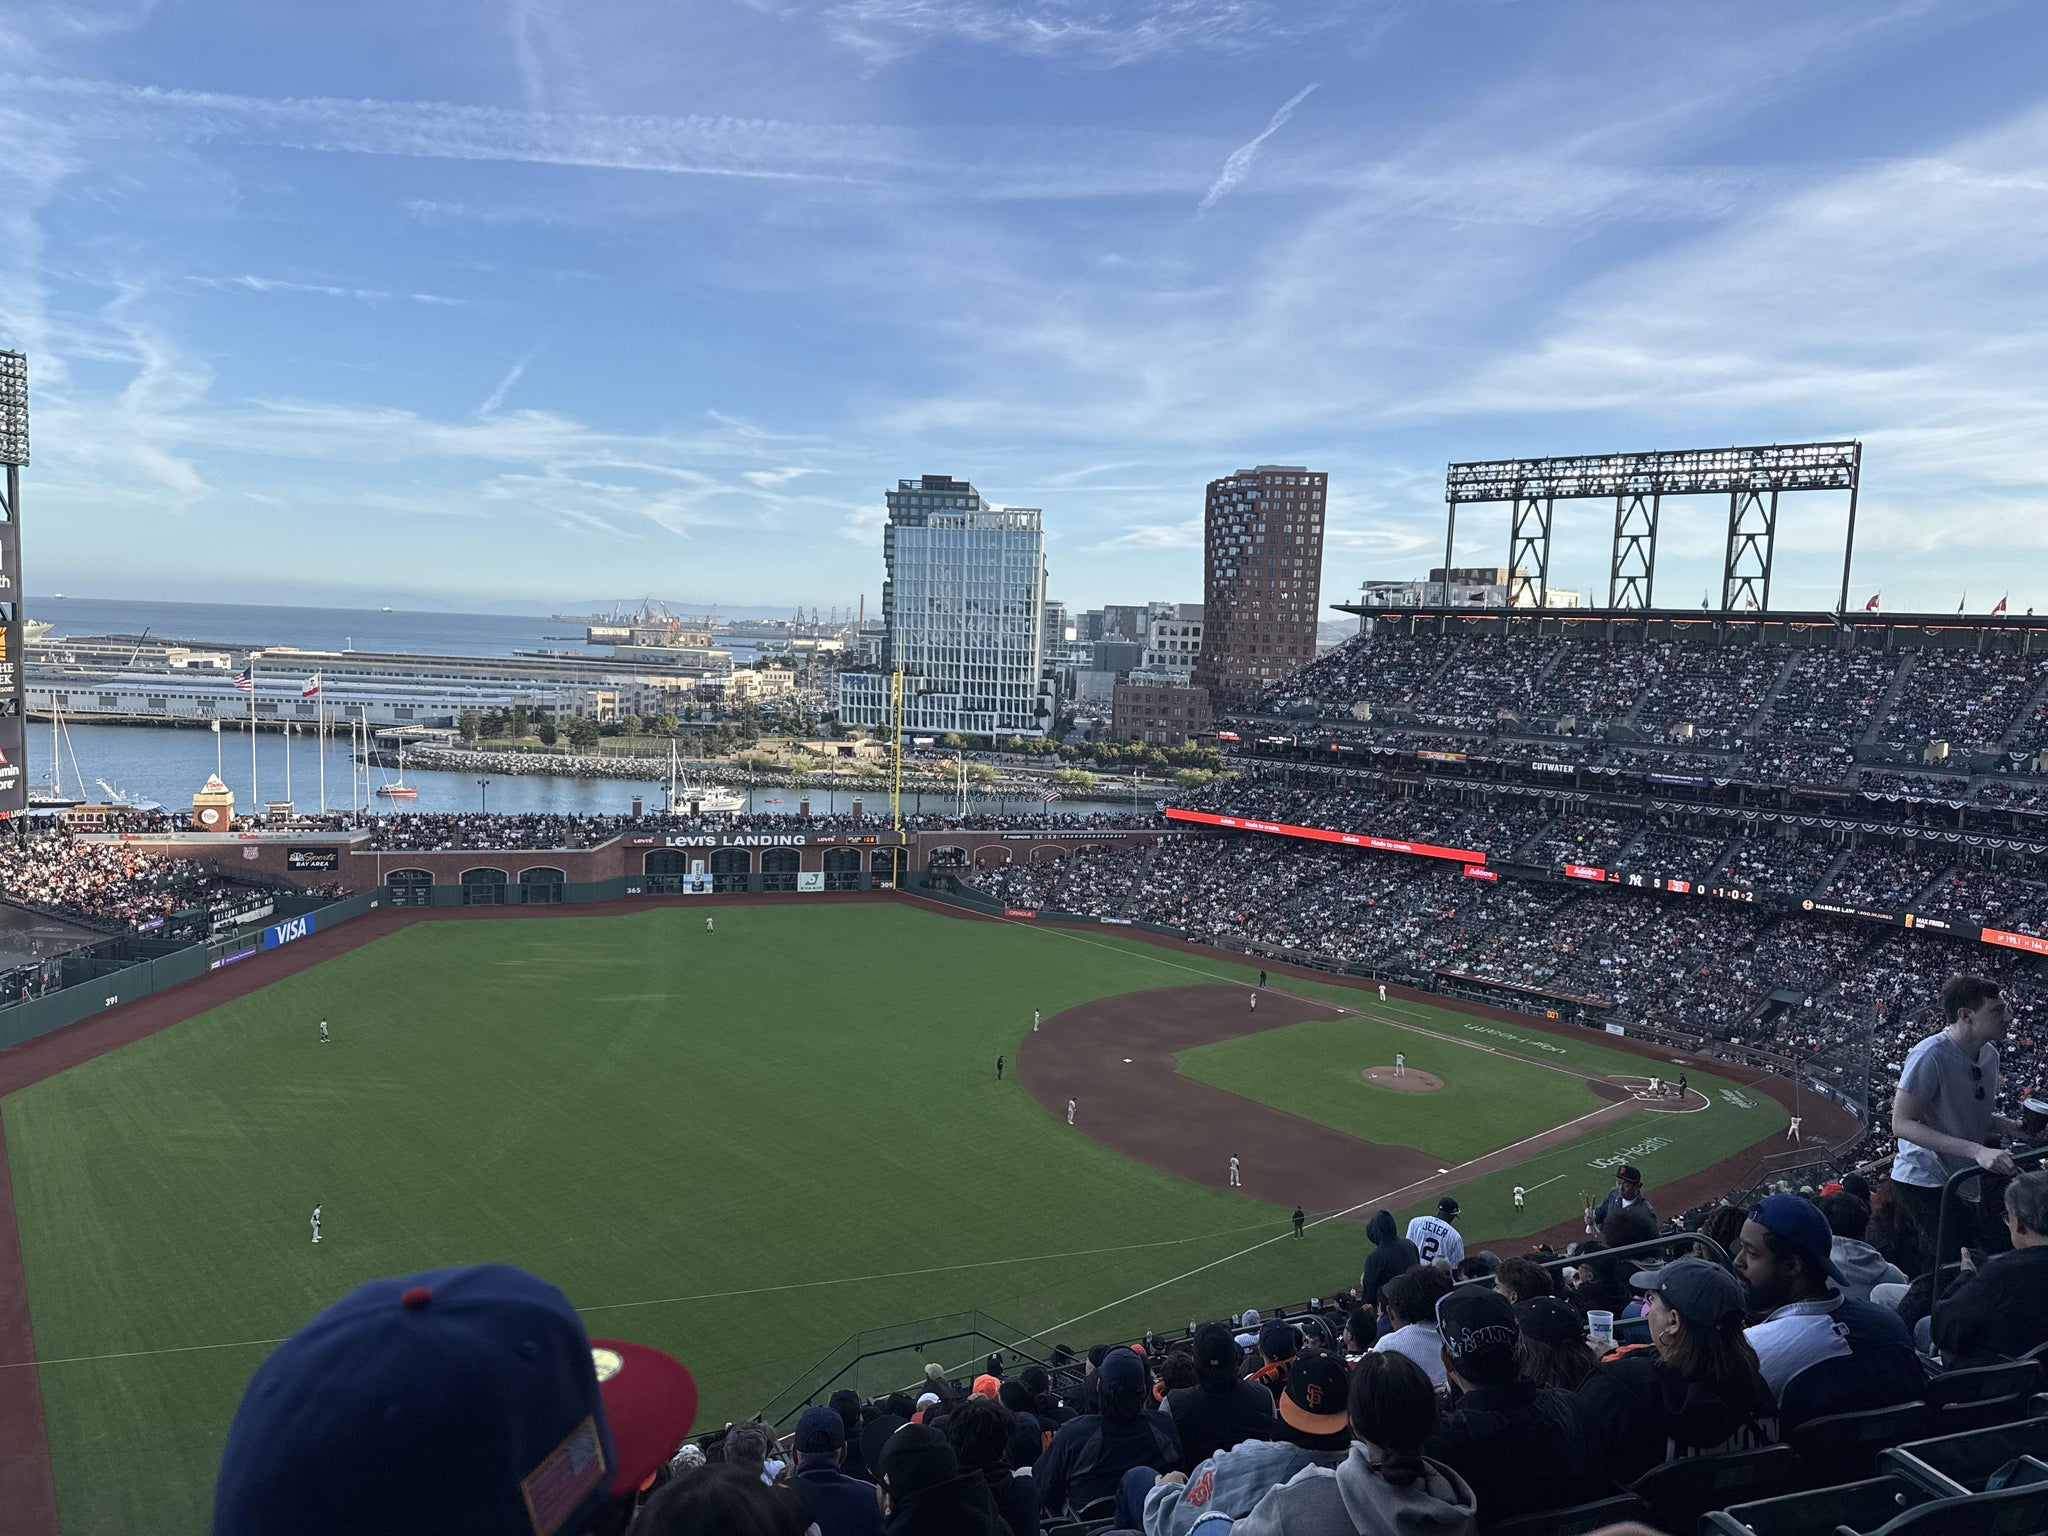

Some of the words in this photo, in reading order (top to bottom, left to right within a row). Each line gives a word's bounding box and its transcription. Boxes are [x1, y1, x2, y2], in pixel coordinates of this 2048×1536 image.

[1531, 761, 1574, 773] CUTWATER
[991, 795, 1037, 803] AMERICA
[11, 808, 29, 817] LIGHT
[1245, 821, 1258, 829] Made
[722, 835, 806, 846] LANDING
[1342, 835, 1359, 843] Adobe
[1371, 839, 1386, 847] Made
[304, 852, 336, 862] Sports
[1574, 867, 1598, 877] Adobe
[1654, 879, 1661, 888] 5
[1697, 885, 1705, 894] 0
[1719, 888, 1724, 897] 1
[1731, 890, 1739, 899] 0
[1745, 892, 1753, 901] 2
[242, 904, 248, 912] TO
[1916, 917, 1928, 925] MAX
[1928, 919, 1945, 928] FRIED
[274, 918, 307, 944] VISA
[2006, 936, 2021, 944] 195.1
[105, 995, 118, 1006] 391
[1546, 1010, 1558, 1019] 007
[1613, 1136, 1674, 1160] Health
[1422, 1221, 1448, 1238] JETER
[1421, 1236, 1439, 1262] 2
[1307, 1383, 1323, 1408] SF
